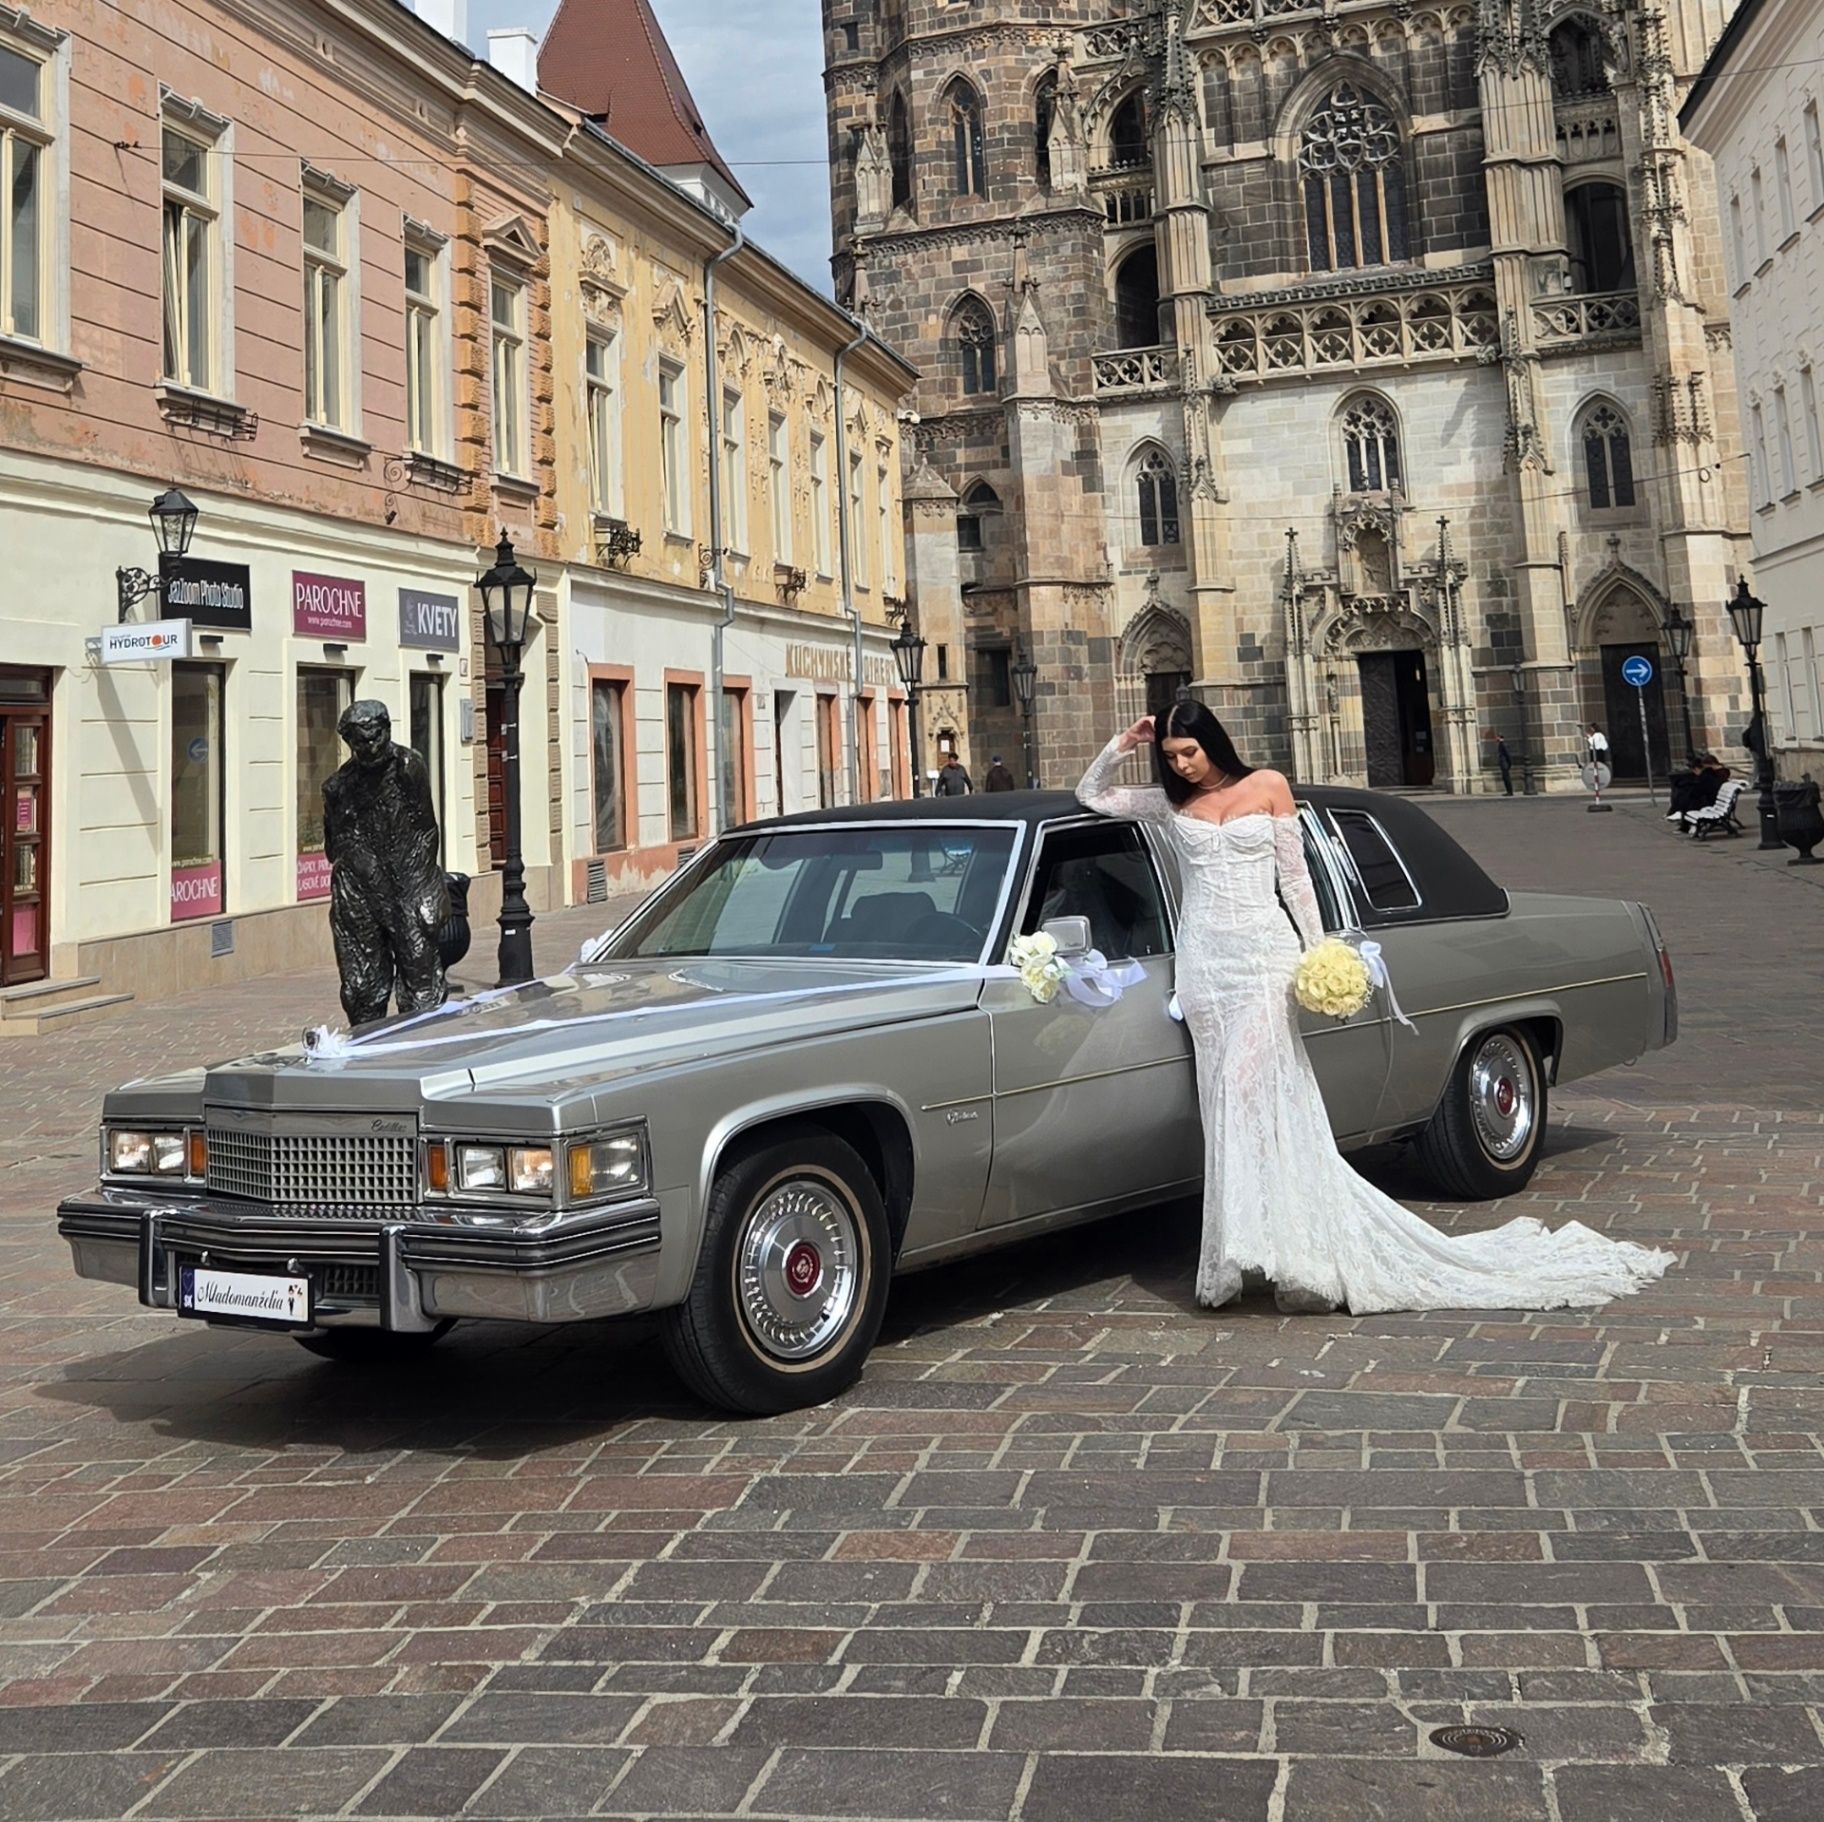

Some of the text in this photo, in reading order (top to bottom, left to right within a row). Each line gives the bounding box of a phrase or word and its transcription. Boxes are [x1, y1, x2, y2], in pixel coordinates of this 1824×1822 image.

[200, 579, 221, 607] Photo
[221, 582, 244, 610] Studio
[296, 582, 363, 618] PAROCHNE
[417, 602, 457, 638] KVETY
[109, 634, 178, 650] HYDROTOUR
[171, 876, 218, 902] AROCHNE
